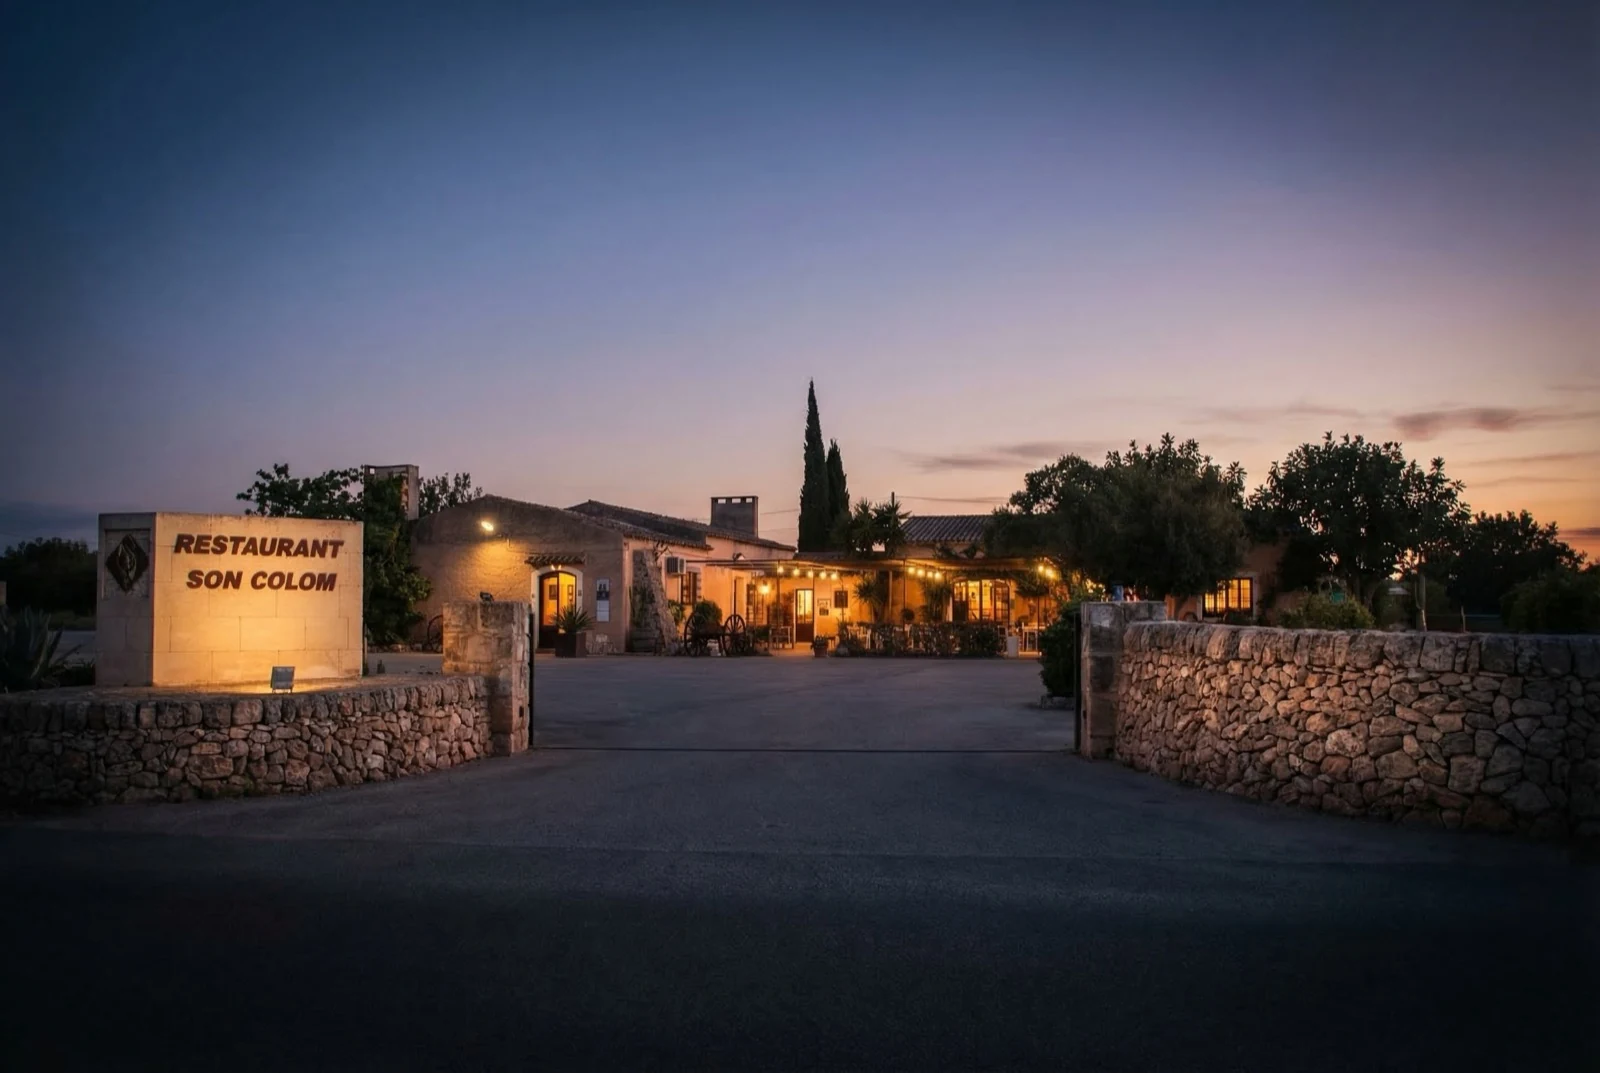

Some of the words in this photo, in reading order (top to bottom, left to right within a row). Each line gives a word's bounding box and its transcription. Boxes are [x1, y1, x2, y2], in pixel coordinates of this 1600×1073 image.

[174, 533, 344, 559] RESTAURANT
[186, 570, 243, 590] SON
[250, 571, 338, 592] COLOM
